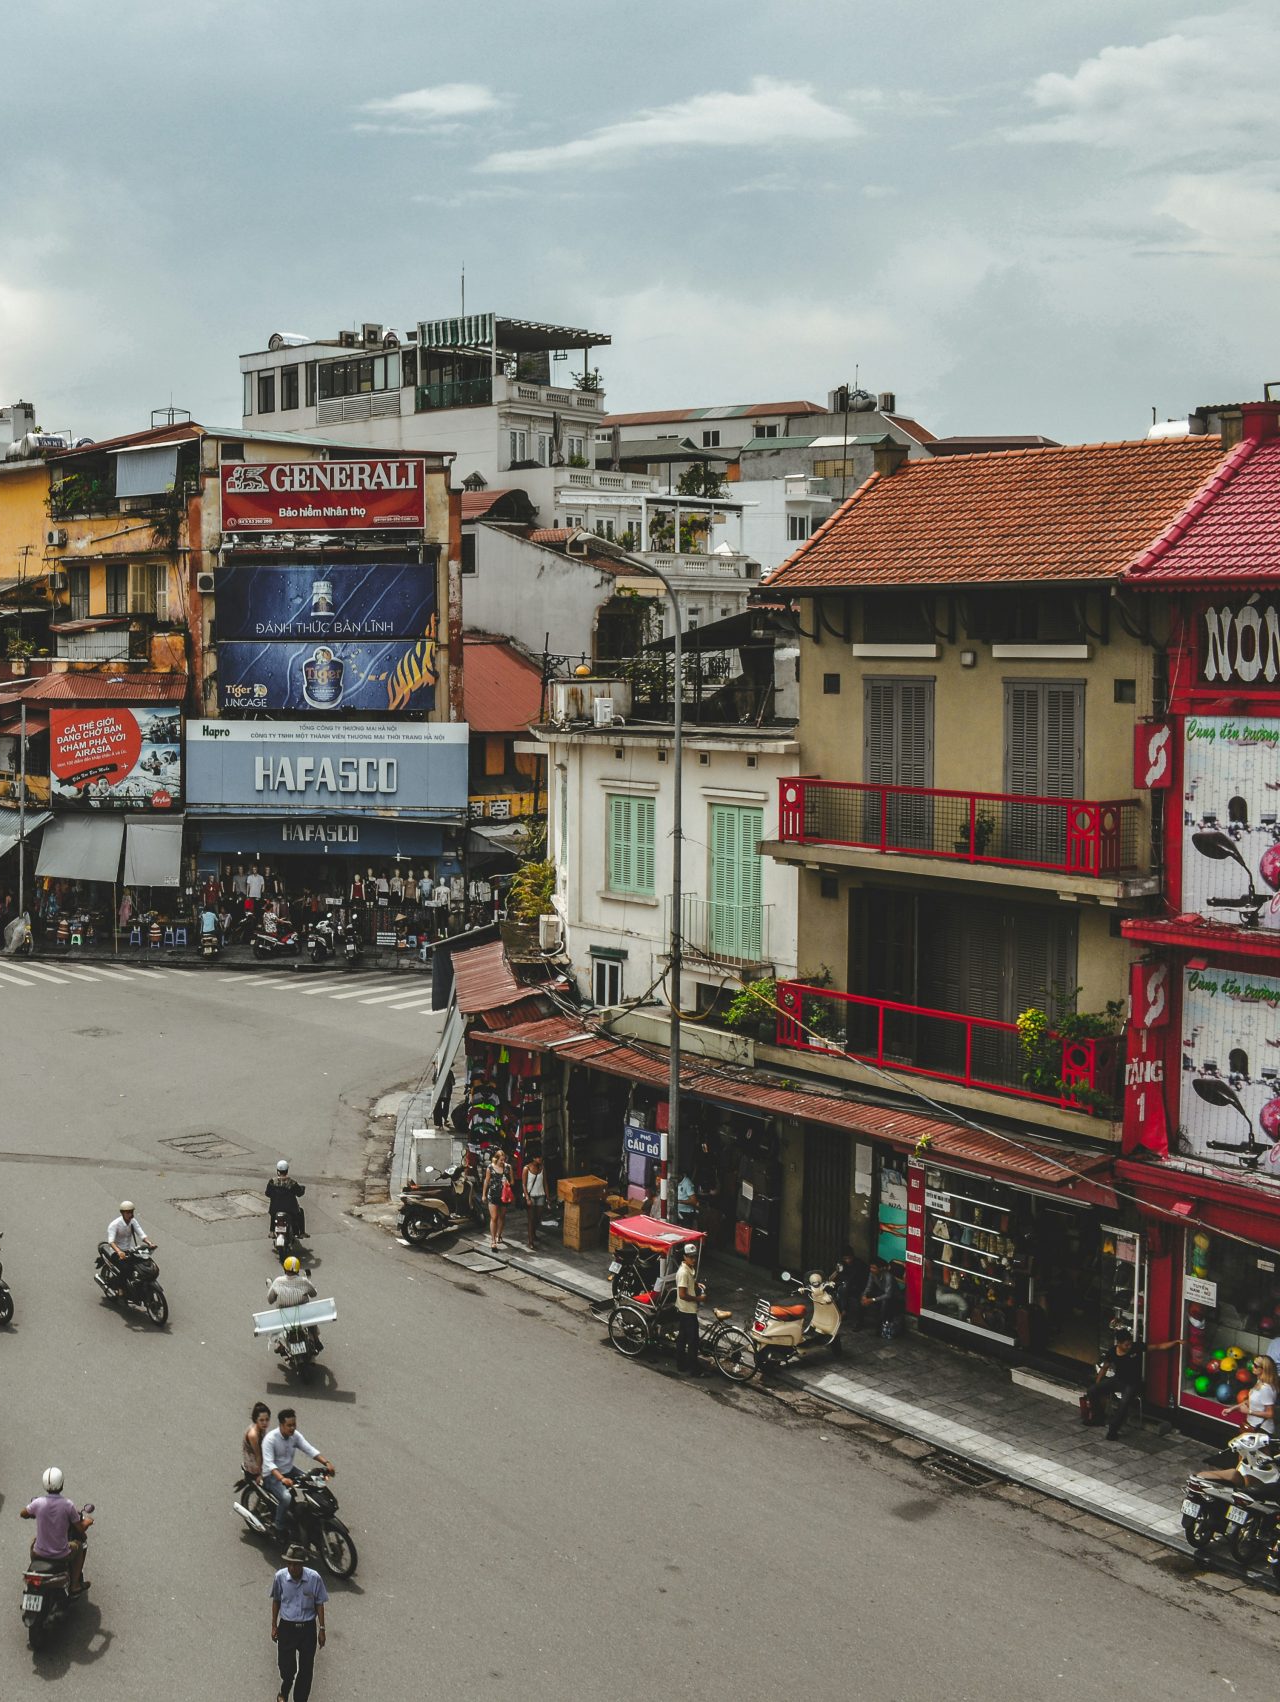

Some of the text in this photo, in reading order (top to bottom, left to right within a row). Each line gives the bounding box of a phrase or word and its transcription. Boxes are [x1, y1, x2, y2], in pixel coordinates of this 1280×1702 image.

[270, 461, 417, 492] GENERALI
[279, 504, 366, 518] Bảo hiểm Nhân thọ
[255, 618, 394, 634] ĐÁNH THỨC BẢN LĨNH
[305, 665, 341, 685] Tiger
[225, 683, 251, 697] Tiger
[225, 698, 267, 708] UNCAGE
[57, 724, 122, 744] ĐANG CHỜ BẠN
[64, 717, 115, 735] CẢ THẾ GIỚI
[202, 725, 230, 739] Hapro
[1186, 718, 1280, 745] Cùng đến trường
[60, 733, 126, 753] KHÁM PHÁ VỚI
[75, 745, 111, 758] AIRASIA
[255, 756, 398, 793] HAFASCO
[282, 823, 359, 843] HAFASCO
[1187, 971, 1217, 998] Cùng
[1221, 978, 1241, 995] đến
[1137, 1092, 1145, 1122] 1
[627, 1137, 660, 1155] CẦU GỖ
